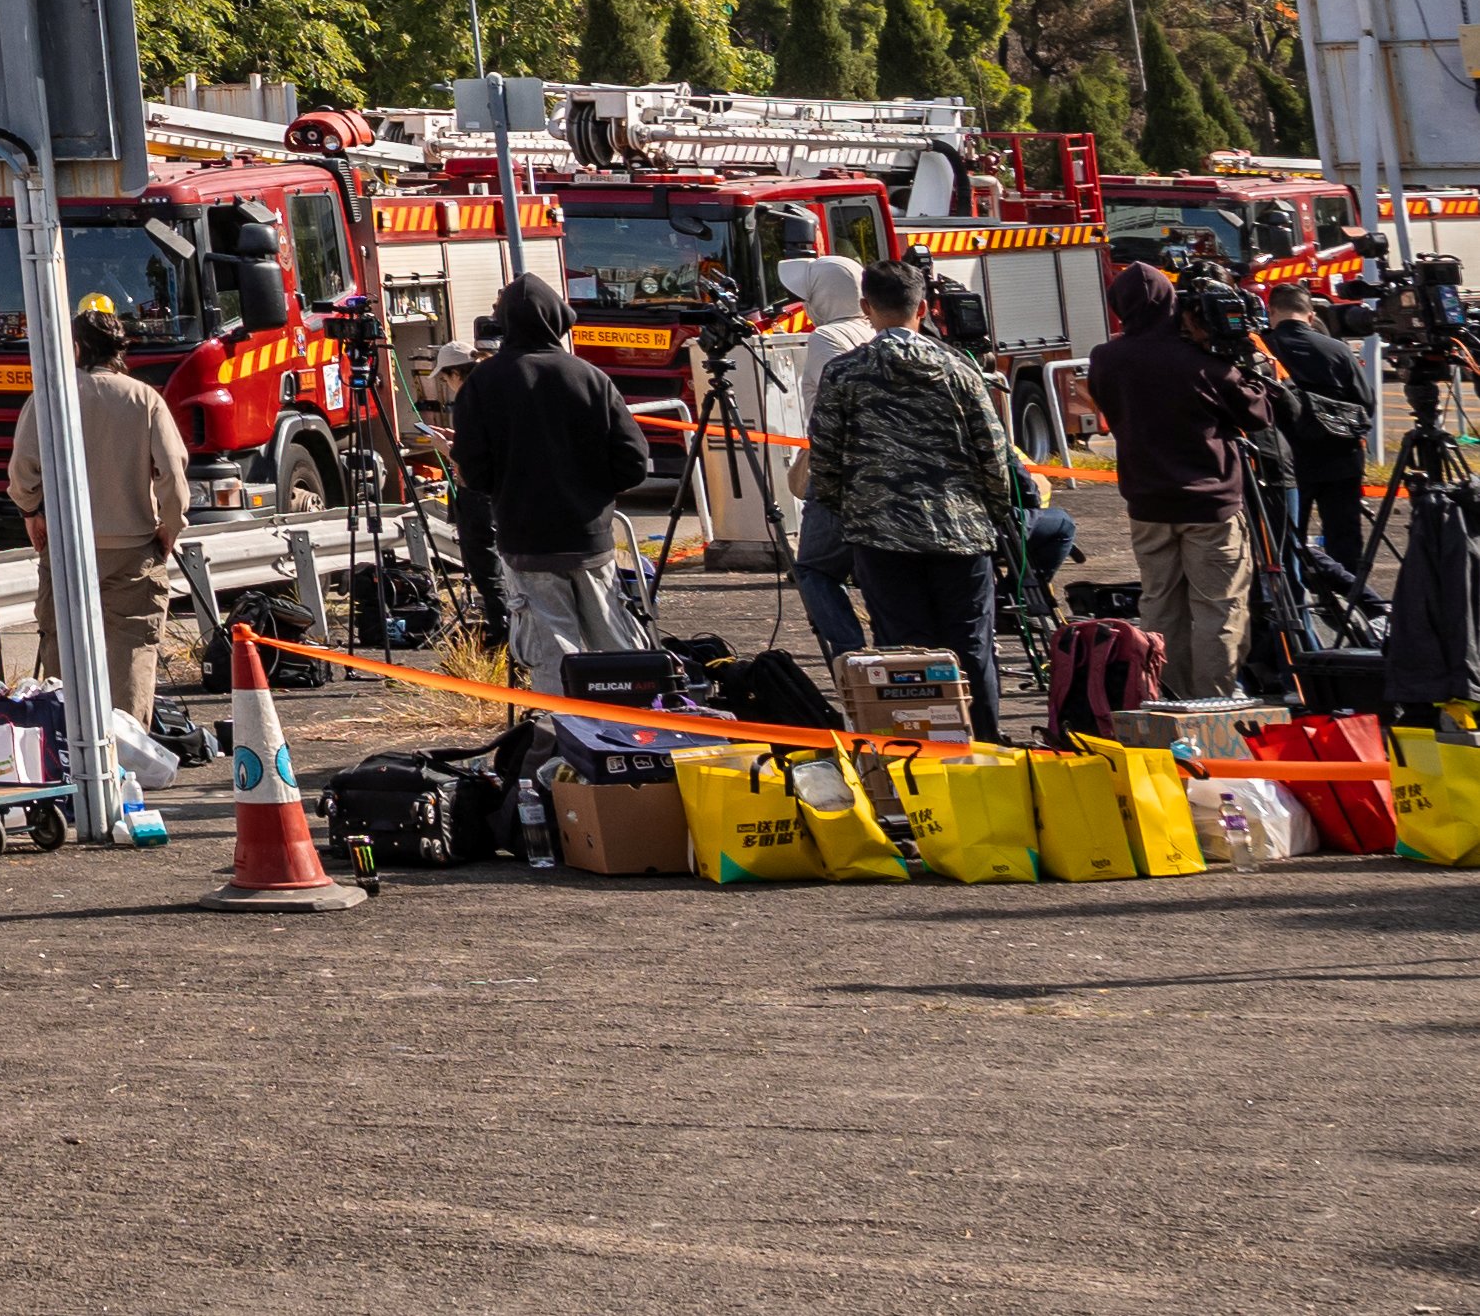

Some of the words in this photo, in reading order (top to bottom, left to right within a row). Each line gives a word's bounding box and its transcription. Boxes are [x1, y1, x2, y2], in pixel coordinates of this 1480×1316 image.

[573, 330, 595, 342] FIRE
[598, 331, 650, 344] SERVICES
[587, 681, 632, 691] PELICAN
[635, 681, 657, 691] AIR
[883, 687, 936, 698] PELICAN
